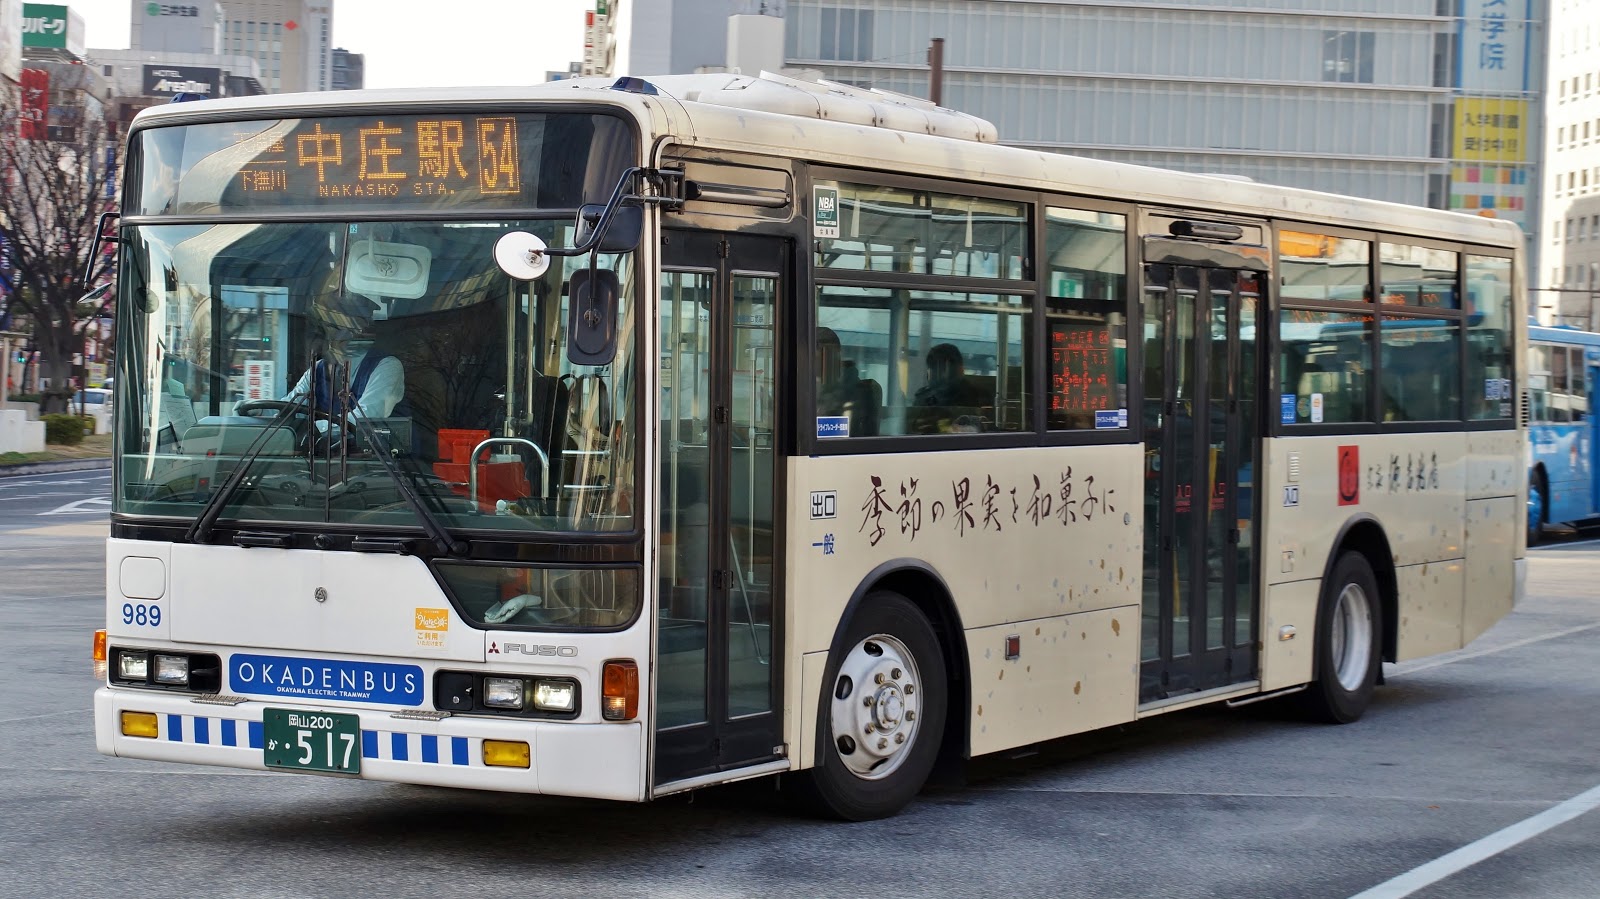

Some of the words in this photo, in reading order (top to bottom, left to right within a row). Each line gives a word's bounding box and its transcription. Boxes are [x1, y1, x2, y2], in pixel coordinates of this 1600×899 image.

[1480, 0, 1507, 70] 学院
[298, 121, 468, 181] 中庄駅
[481, 122, 515, 188] 54
[319, 183, 399, 197] NAKASHO
[413, 182, 456, 195] STA.
[818, 196, 835, 209] NBA
[812, 494, 835, 517] 出口
[812, 533, 834, 555] 一般
[122, 603, 161, 627] 989
[503, 642, 579, 658] FUSO
[239, 661, 416, 694] OKADENBUS
[276, 686, 306, 694] OKAYAMA
[307, 689, 338, 697] ELECTRIC
[339, 691, 371, 699] TRAMWAY
